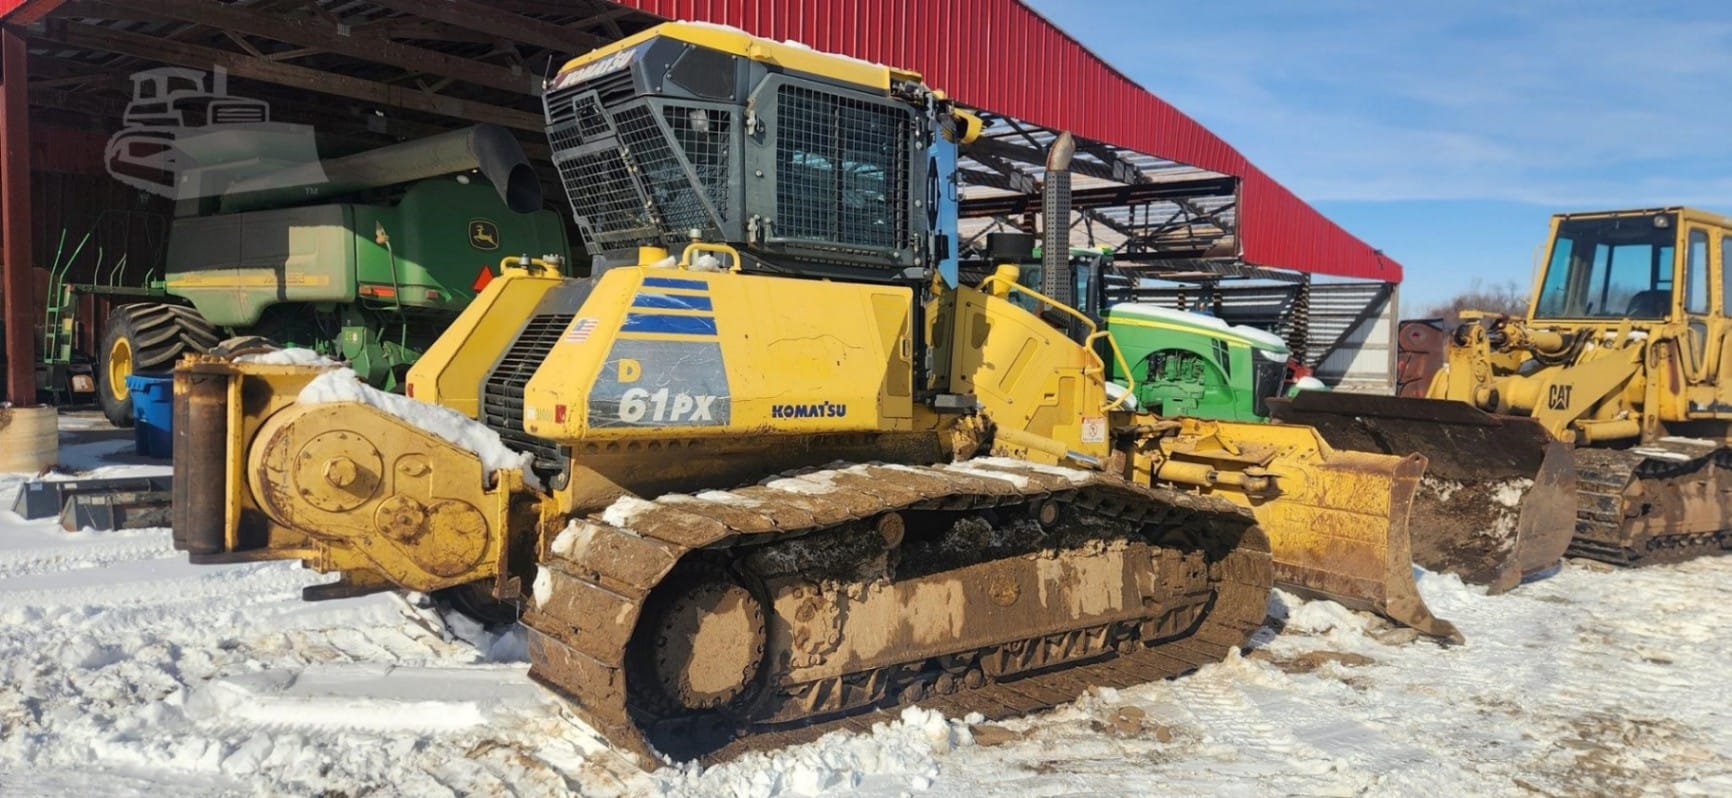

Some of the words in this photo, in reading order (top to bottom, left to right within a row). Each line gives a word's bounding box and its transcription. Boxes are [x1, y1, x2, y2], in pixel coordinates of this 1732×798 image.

[617, 358, 642, 383] D
[618, 387, 716, 422] 61PX
[1549, 384, 1572, 410] CAT
[771, 403, 846, 418] KOMATSU
